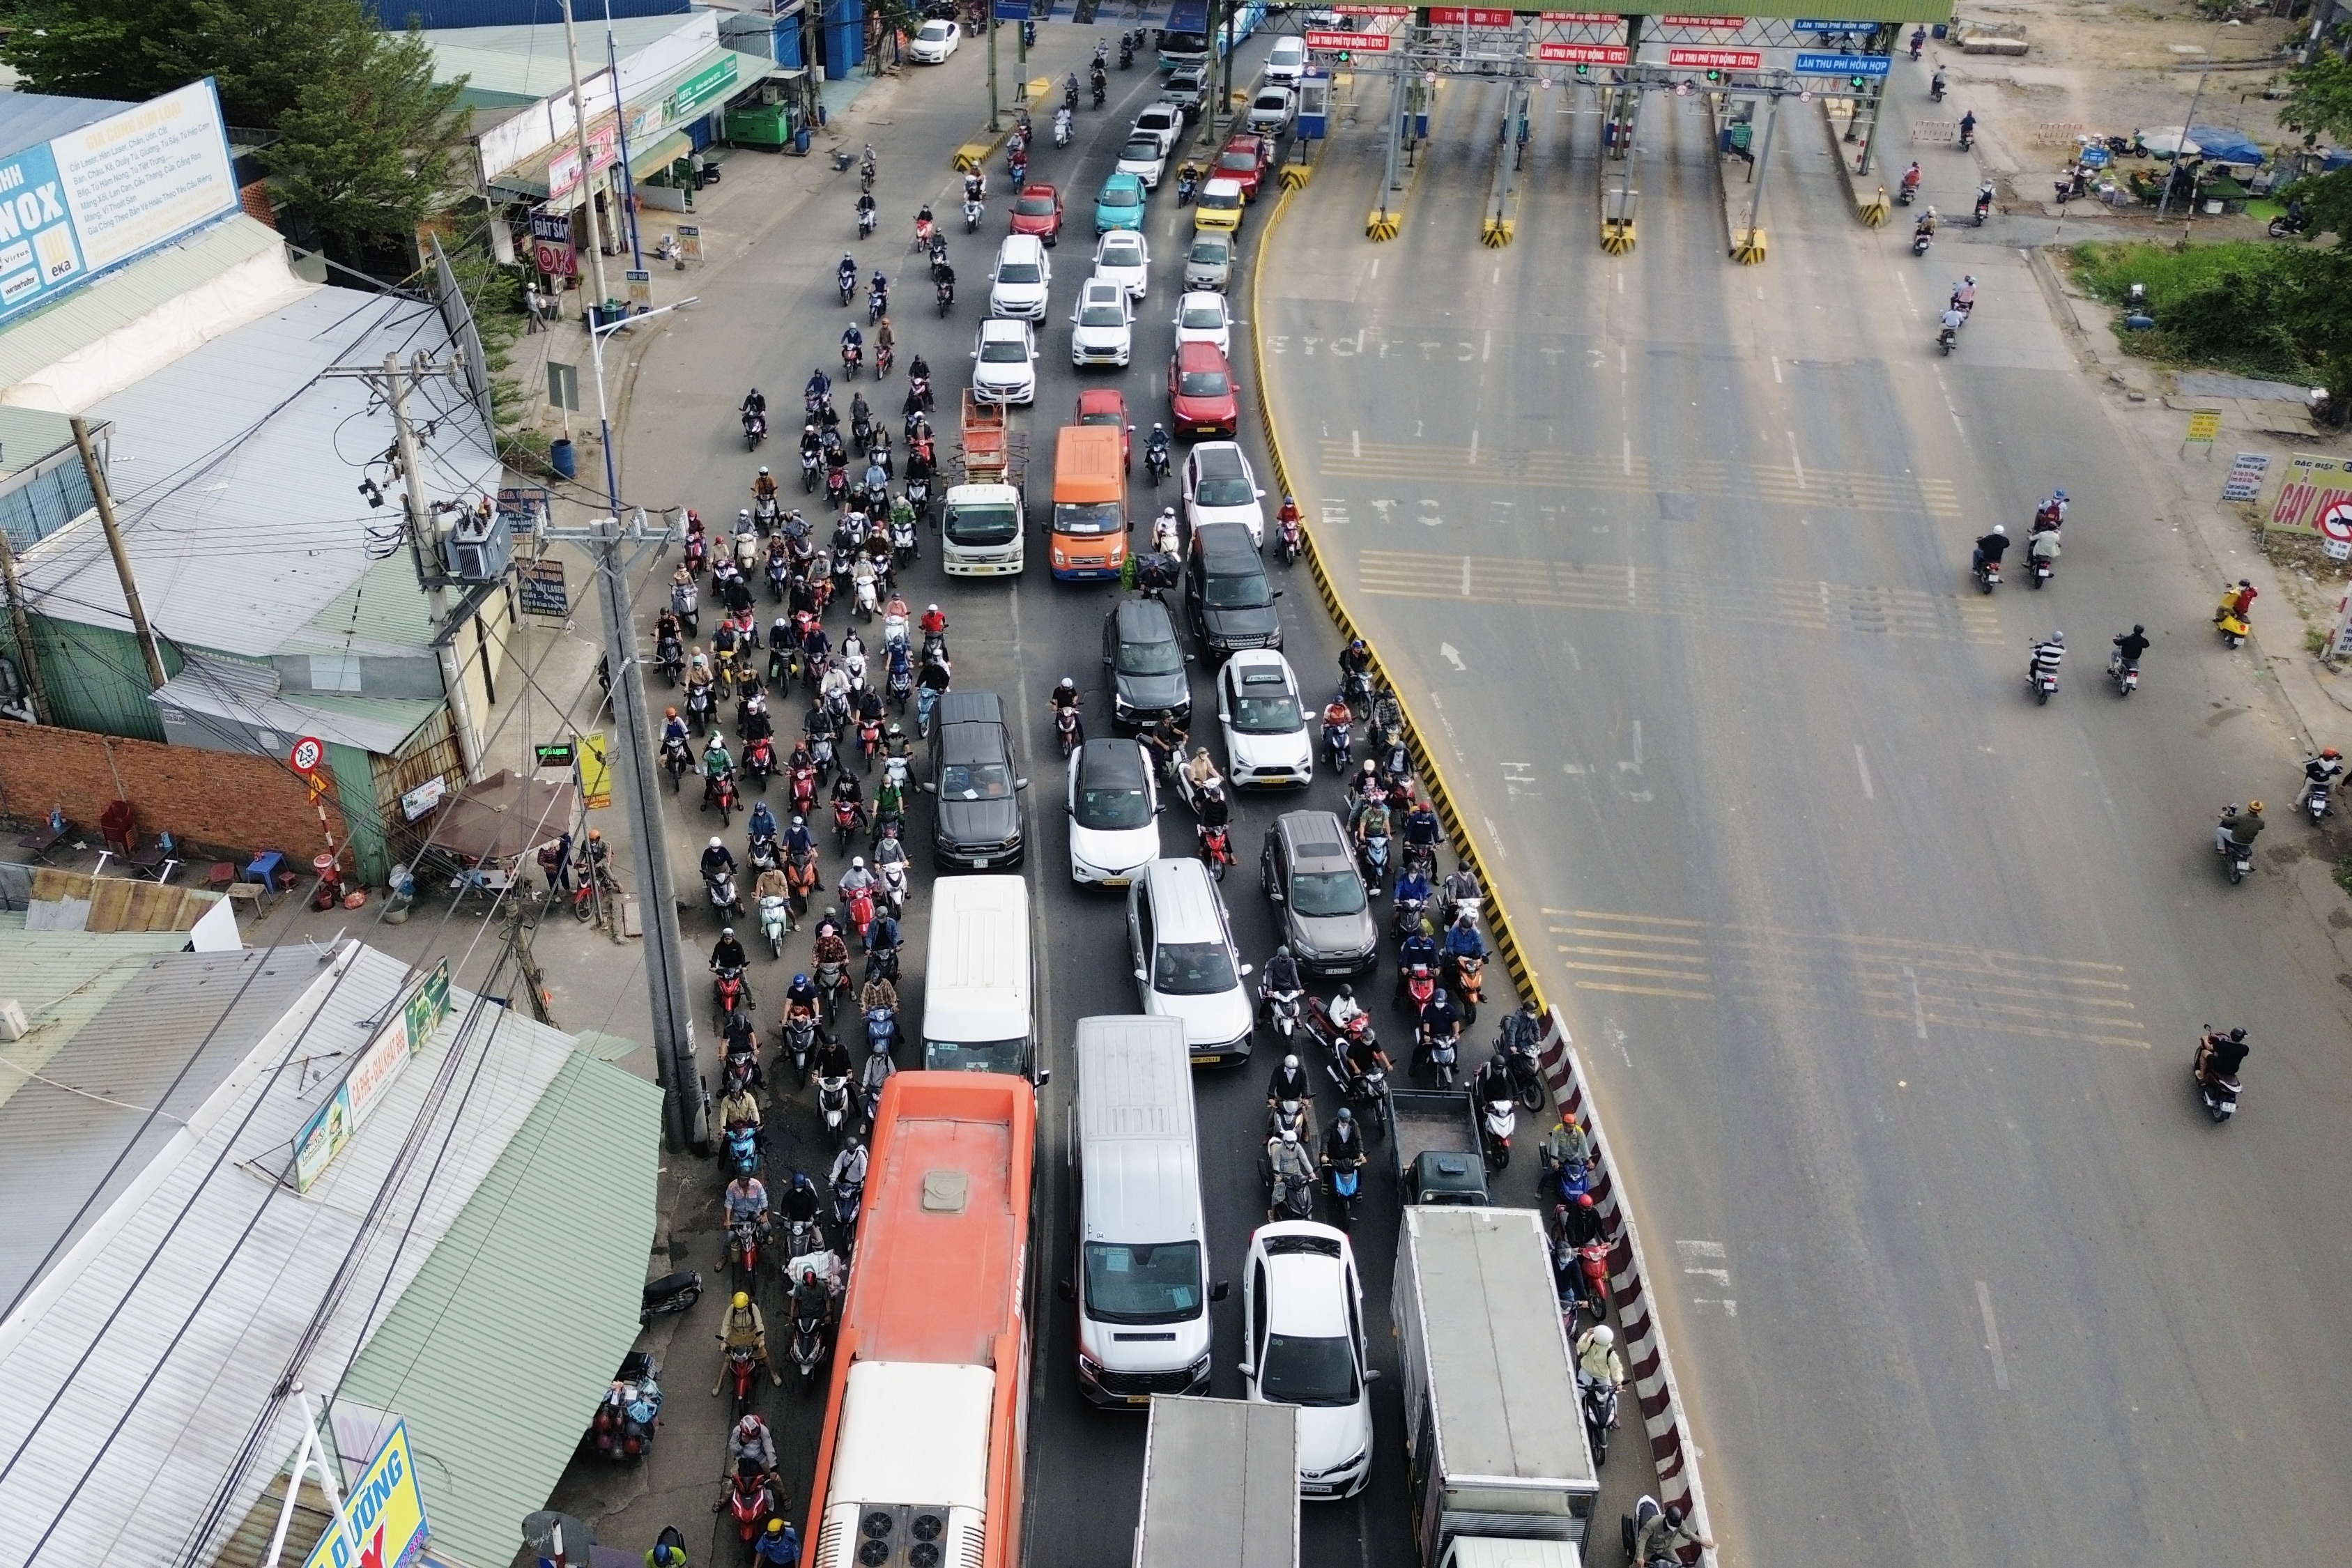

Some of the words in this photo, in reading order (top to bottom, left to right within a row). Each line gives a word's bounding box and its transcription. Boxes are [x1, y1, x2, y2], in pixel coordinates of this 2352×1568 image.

[1308, 33, 1320, 45] LÀN
[1321, 36, 1332, 45] THU
[1332, 34, 1342, 45] PHÍ
[1343, 37, 1351, 48] TỰ
[1351, 35, 1367, 48] ĐỘNG
[1540, 45, 1553, 57] LÀN
[1553, 49, 1566, 58] THU
[1566, 47, 1577, 59] PHÍ
[1578, 49, 1588, 61] TỰ
[1588, 49, 1604, 61] ĐỘNG
[1671, 50, 1684, 62] LÀN
[1685, 53, 1697, 63] THU
[1698, 52, 1710, 63] PHÍ
[1710, 54, 1719, 66] TỰ
[1719, 53, 1736, 66] ĐỘNG
[1797, 57, 1814, 68] LÀN
[1815, 60, 1832, 68] THU
[1834, 59, 1848, 69] PHÍ
[1850, 56, 1868, 70] HỖN
[1869, 61, 1887, 72] HỢP
[114, 210, 129, 224] Theo
[162, 188, 176, 202] Theo
[535, 218, 553, 240] GIẶT
[553, 218, 568, 239] SẤY
[4, 249, 29, 263] Virtus
[538, 246, 573, 273] OK
